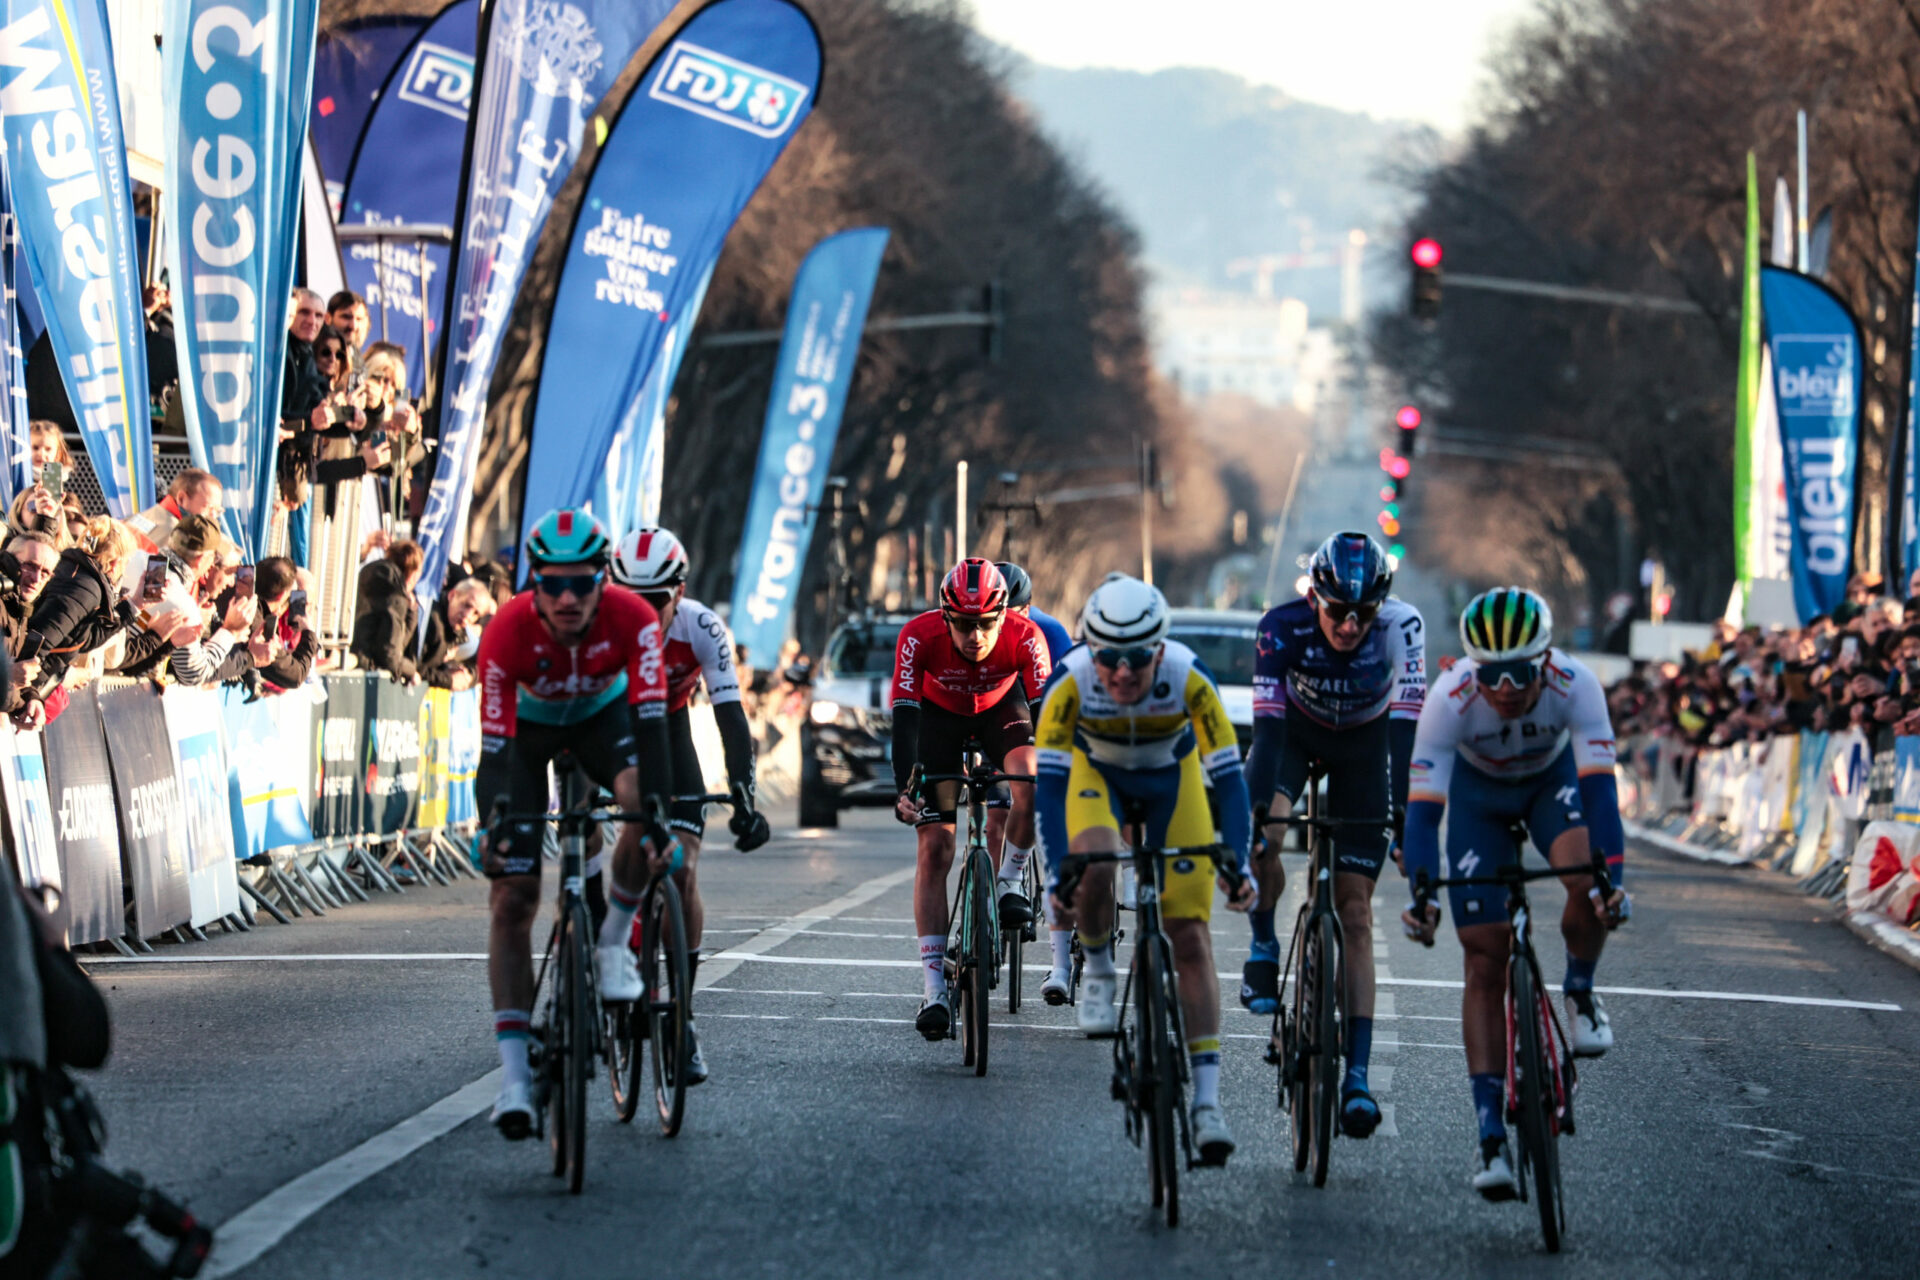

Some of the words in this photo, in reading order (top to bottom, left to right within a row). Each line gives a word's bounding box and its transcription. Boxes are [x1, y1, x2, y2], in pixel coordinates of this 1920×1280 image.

[413, 56, 472, 109] FD
[665, 55, 750, 111] FDJ
[584, 225, 677, 276] gagner
[601, 206, 671, 249] Faire
[1800, 437, 1846, 576] bleu
